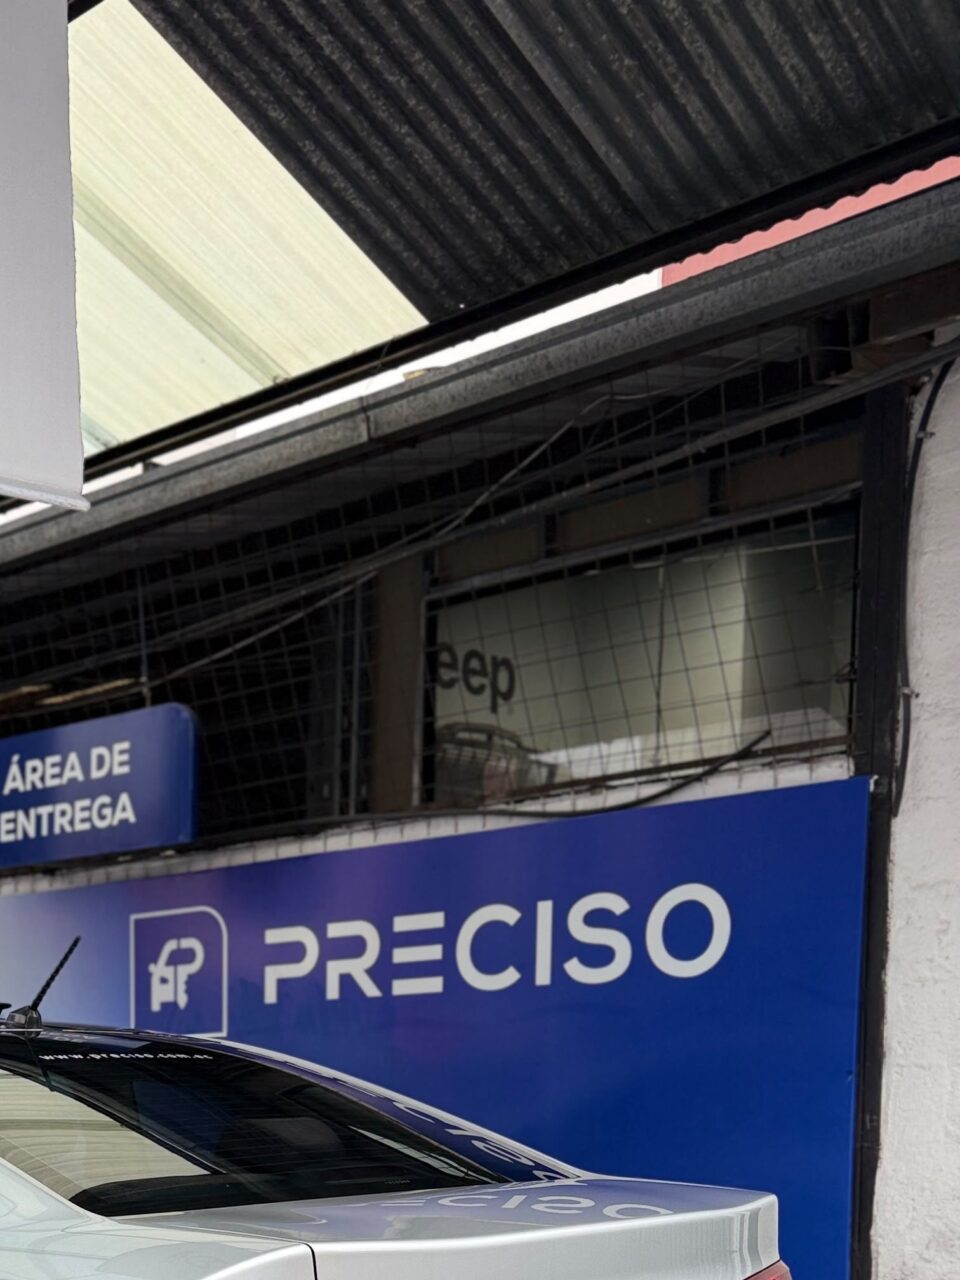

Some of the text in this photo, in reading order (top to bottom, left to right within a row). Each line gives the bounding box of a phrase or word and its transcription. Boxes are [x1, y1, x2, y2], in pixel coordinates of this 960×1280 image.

[438, 641, 516, 714] eep
[2, 741, 131, 796] ÁREA DE
[264, 883, 732, 1004] PRECISO
